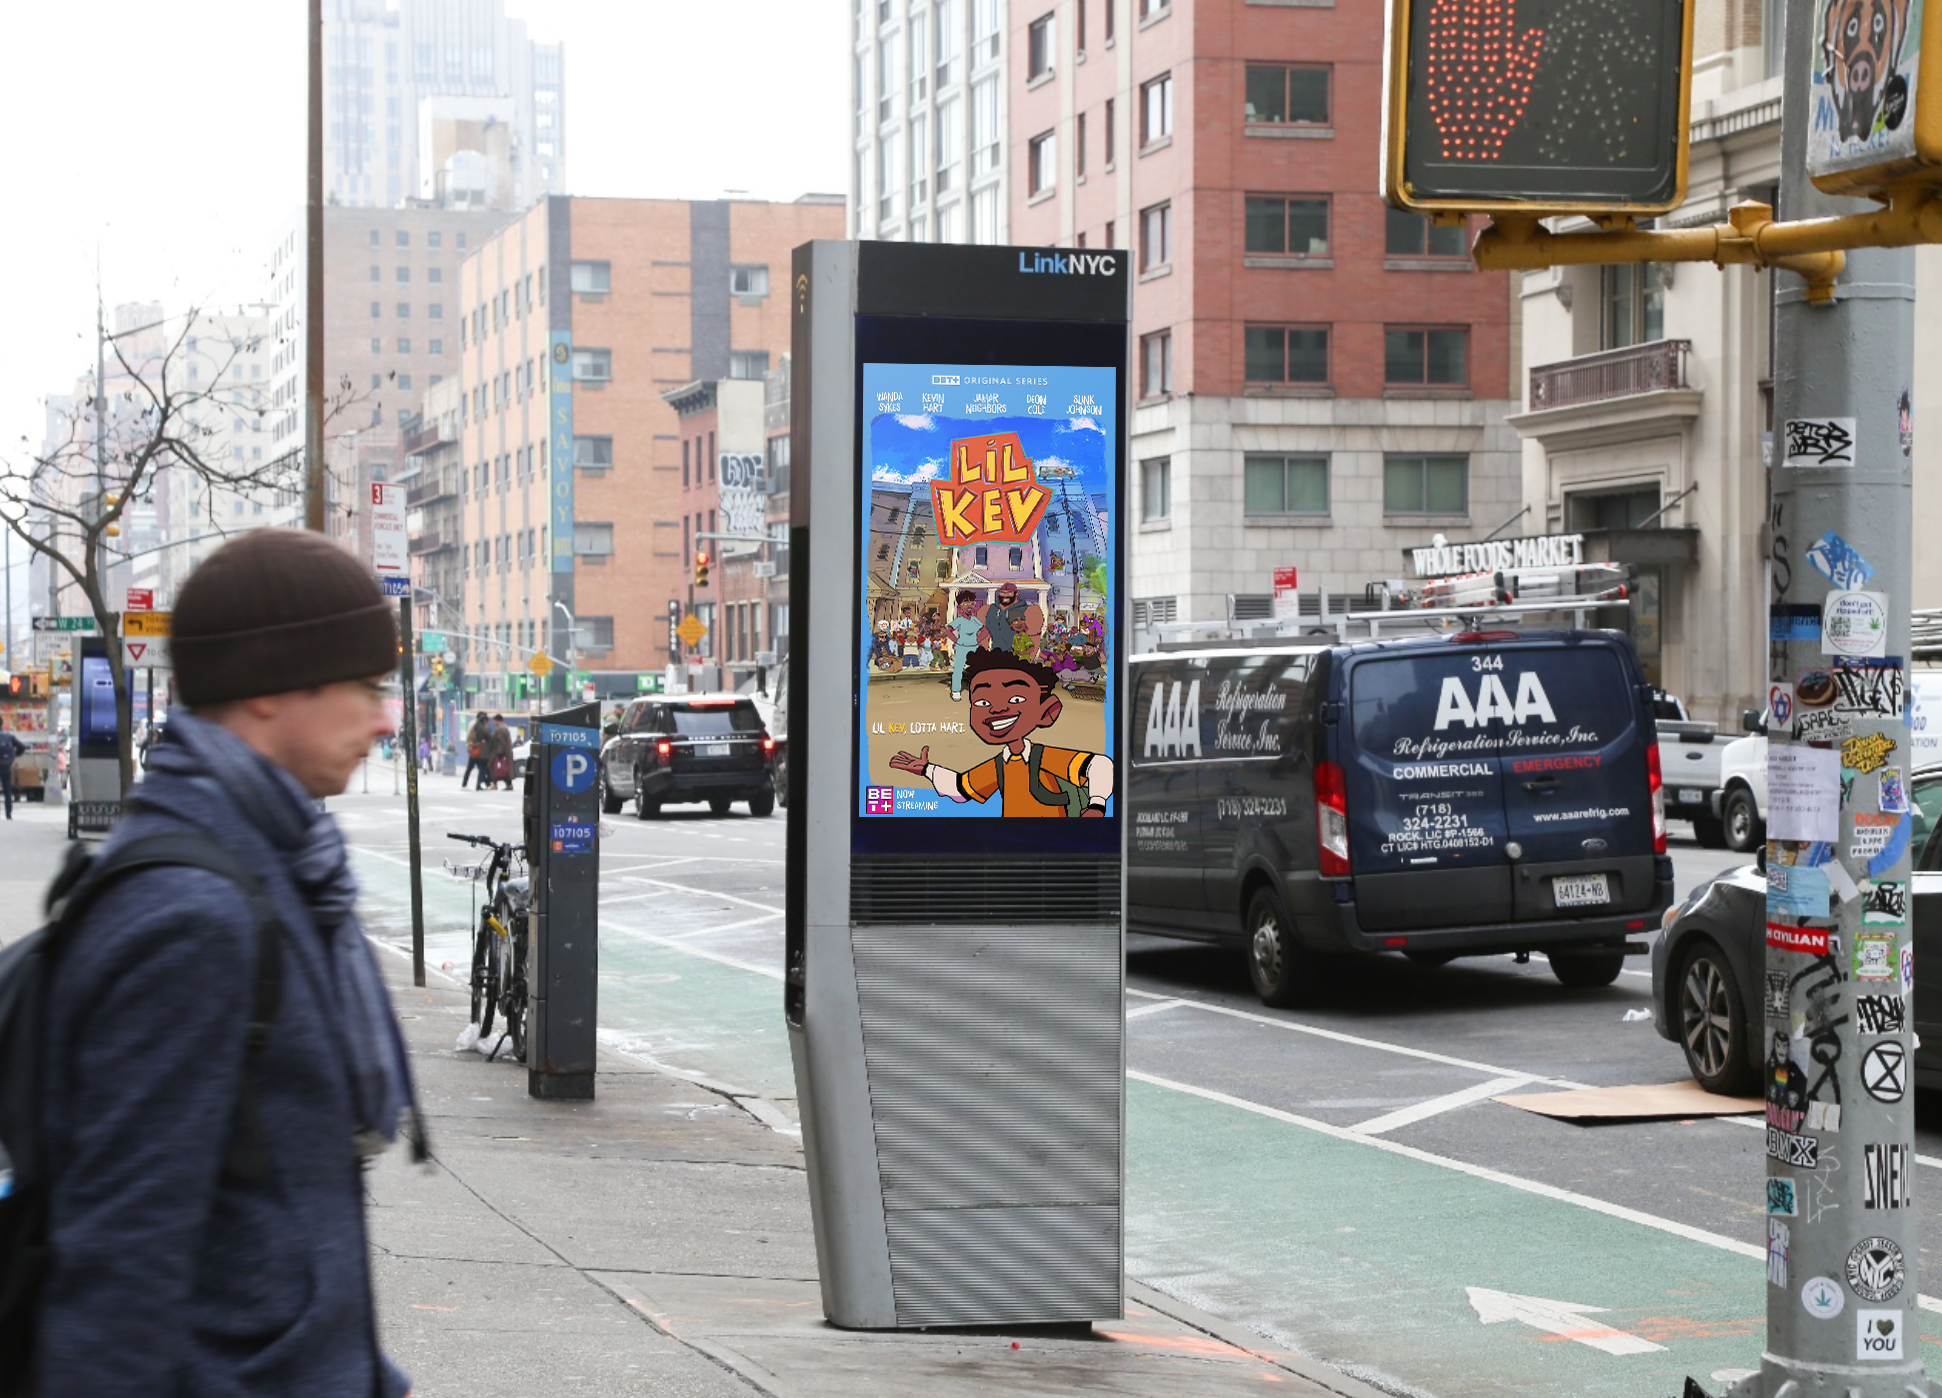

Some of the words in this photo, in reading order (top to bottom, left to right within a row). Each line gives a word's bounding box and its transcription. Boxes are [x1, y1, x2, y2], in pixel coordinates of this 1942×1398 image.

[1019, 251, 1116, 276] LinkNYC
[963, 377, 1012, 386] ORIGINAL
[1015, 377, 1048, 386] SERIES
[876, 391, 904, 403] WANDA
[922, 393, 945, 404] KEVIN
[973, 393, 999, 404] JAMAR
[1026, 394, 1047, 405] DEON
[878, 402, 902, 413] SYKES
[923, 403, 943, 413] HART
[965, 403, 1008, 414] NEIGHBORS
[1027, 405, 1046, 415] COLE
[1066, 404, 1103, 416] JOHNSON
[556, 406, 569, 523] SAVOY
[373, 484, 381, 504] 3
[934, 485, 1048, 541] KEV
[1412, 547, 1464, 576] WHOLE
[1463, 540, 1513, 571] FOODS
[1513, 534, 1585, 568] MARKET
[71, 619, 83, 629] 24
[1471, 655, 1504, 672] 344
[1214, 680, 1287, 723] Refrigeration
[1433, 671, 1558, 731] AAA
[1144, 679, 1203, 758] AAA
[872, 722, 886, 735] LIL
[888, 722, 907, 735] KEV,
[910, 722, 937, 734] LOTTA
[940, 722, 966, 734] HART.
[550, 732, 587, 742] 107105
[1393, 737, 1504, 760] Refrigeration
[565, 754, 588, 787] P
[1393, 763, 1494, 780] COMMERCIAL
[1513, 755, 1602, 774] EMERGENCY
[896, 790, 915, 799] NOW
[1398, 790, 1464, 801] TRANSIT
[896, 801, 939, 811] STREAMING
[1415, 803, 1452, 817] (718)
[1534, 807, 1630, 823] www.aaarefrig.com
[1403, 814, 1469, 831] 324-2231
[553, 827, 591, 838] 107105
[1388, 832, 1424, 843] ROCK.
[1425, 830, 1442, 840] LIC
[1381, 843, 1395, 854] CT
[1773, 929, 1825, 948] CIVILIAN
[1860, 1251, 1895, 1290] NYC
[1867, 1319, 1872, 1334] I
[1863, 1337, 1896, 1351] YOU
